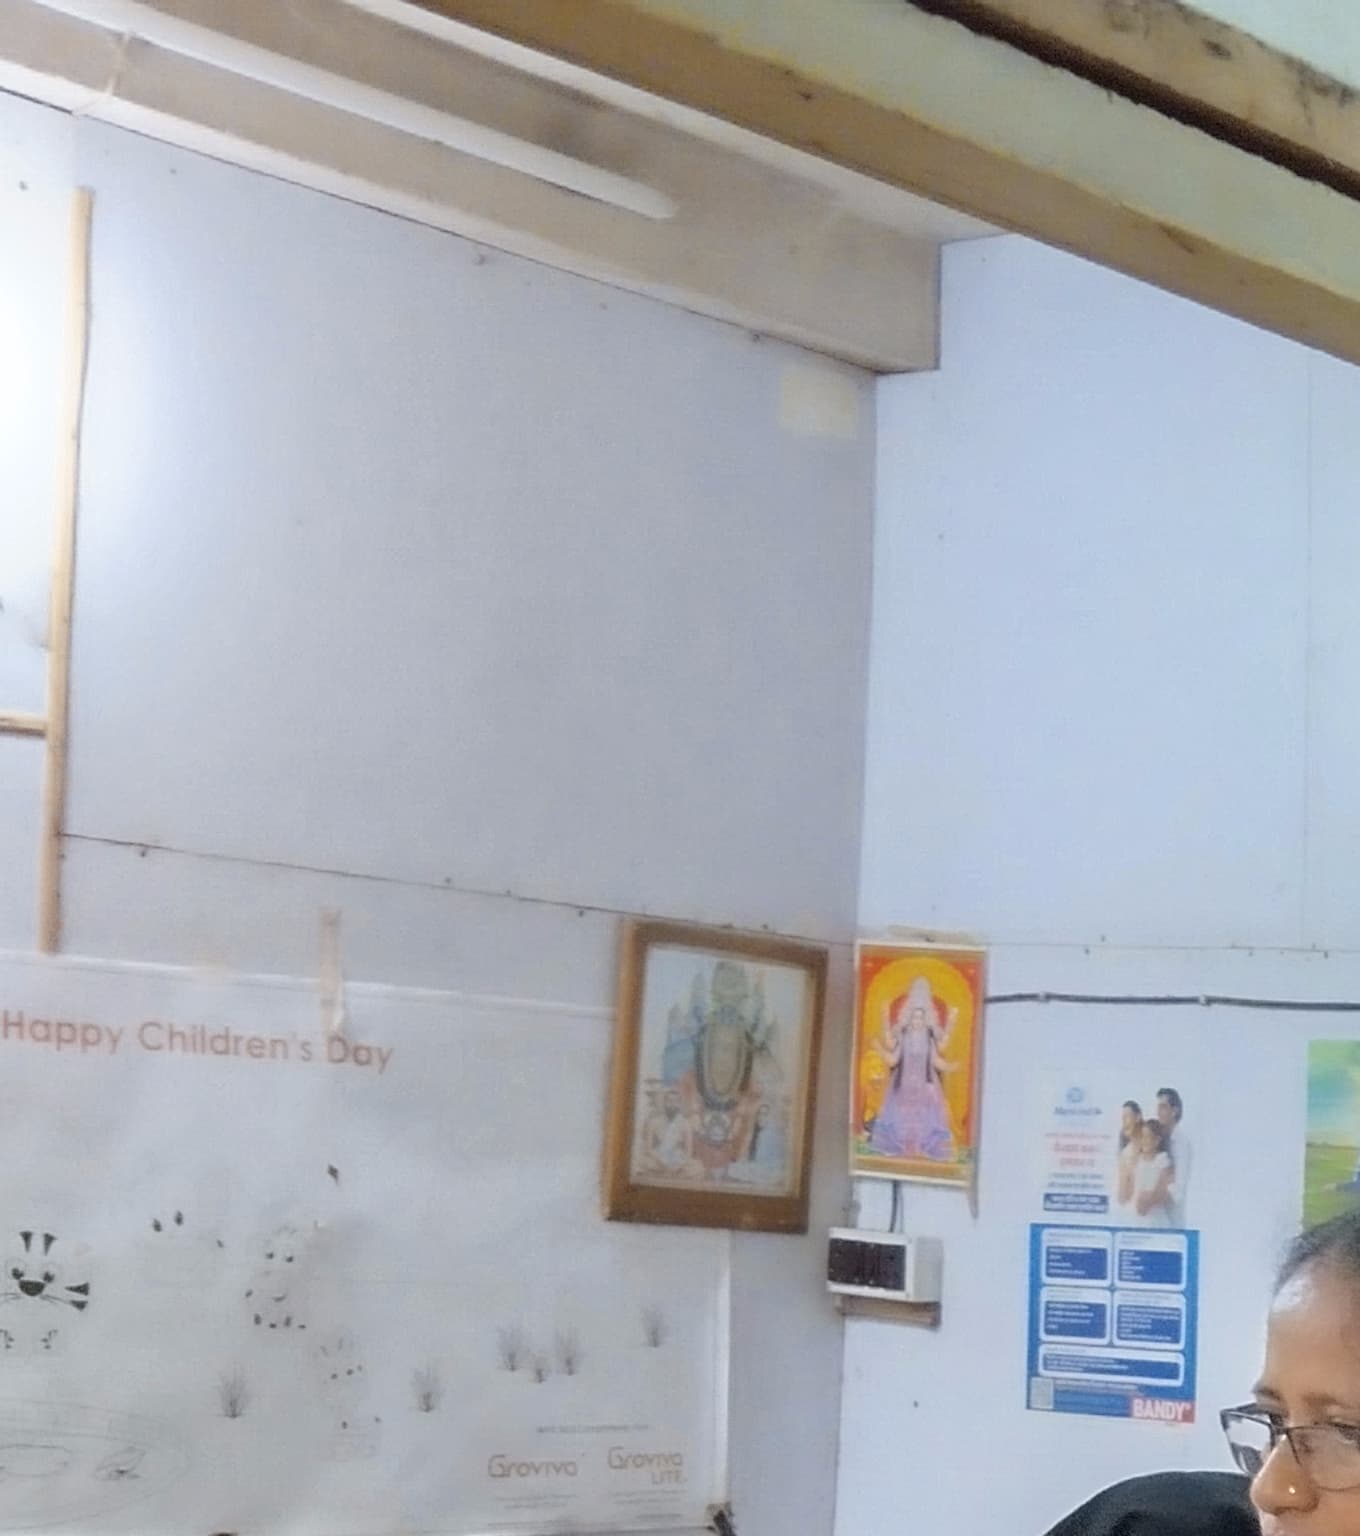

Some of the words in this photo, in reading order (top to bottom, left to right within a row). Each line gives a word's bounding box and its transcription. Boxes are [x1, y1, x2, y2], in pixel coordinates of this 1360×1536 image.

[1, 1009, 122, 1055] Happy
[138, 1020, 314, 1064] Children's
[327, 1034, 395, 1076] Day
[487, 1453, 579, 1479] Groviva
[607, 1445, 684, 1471] Groviva
